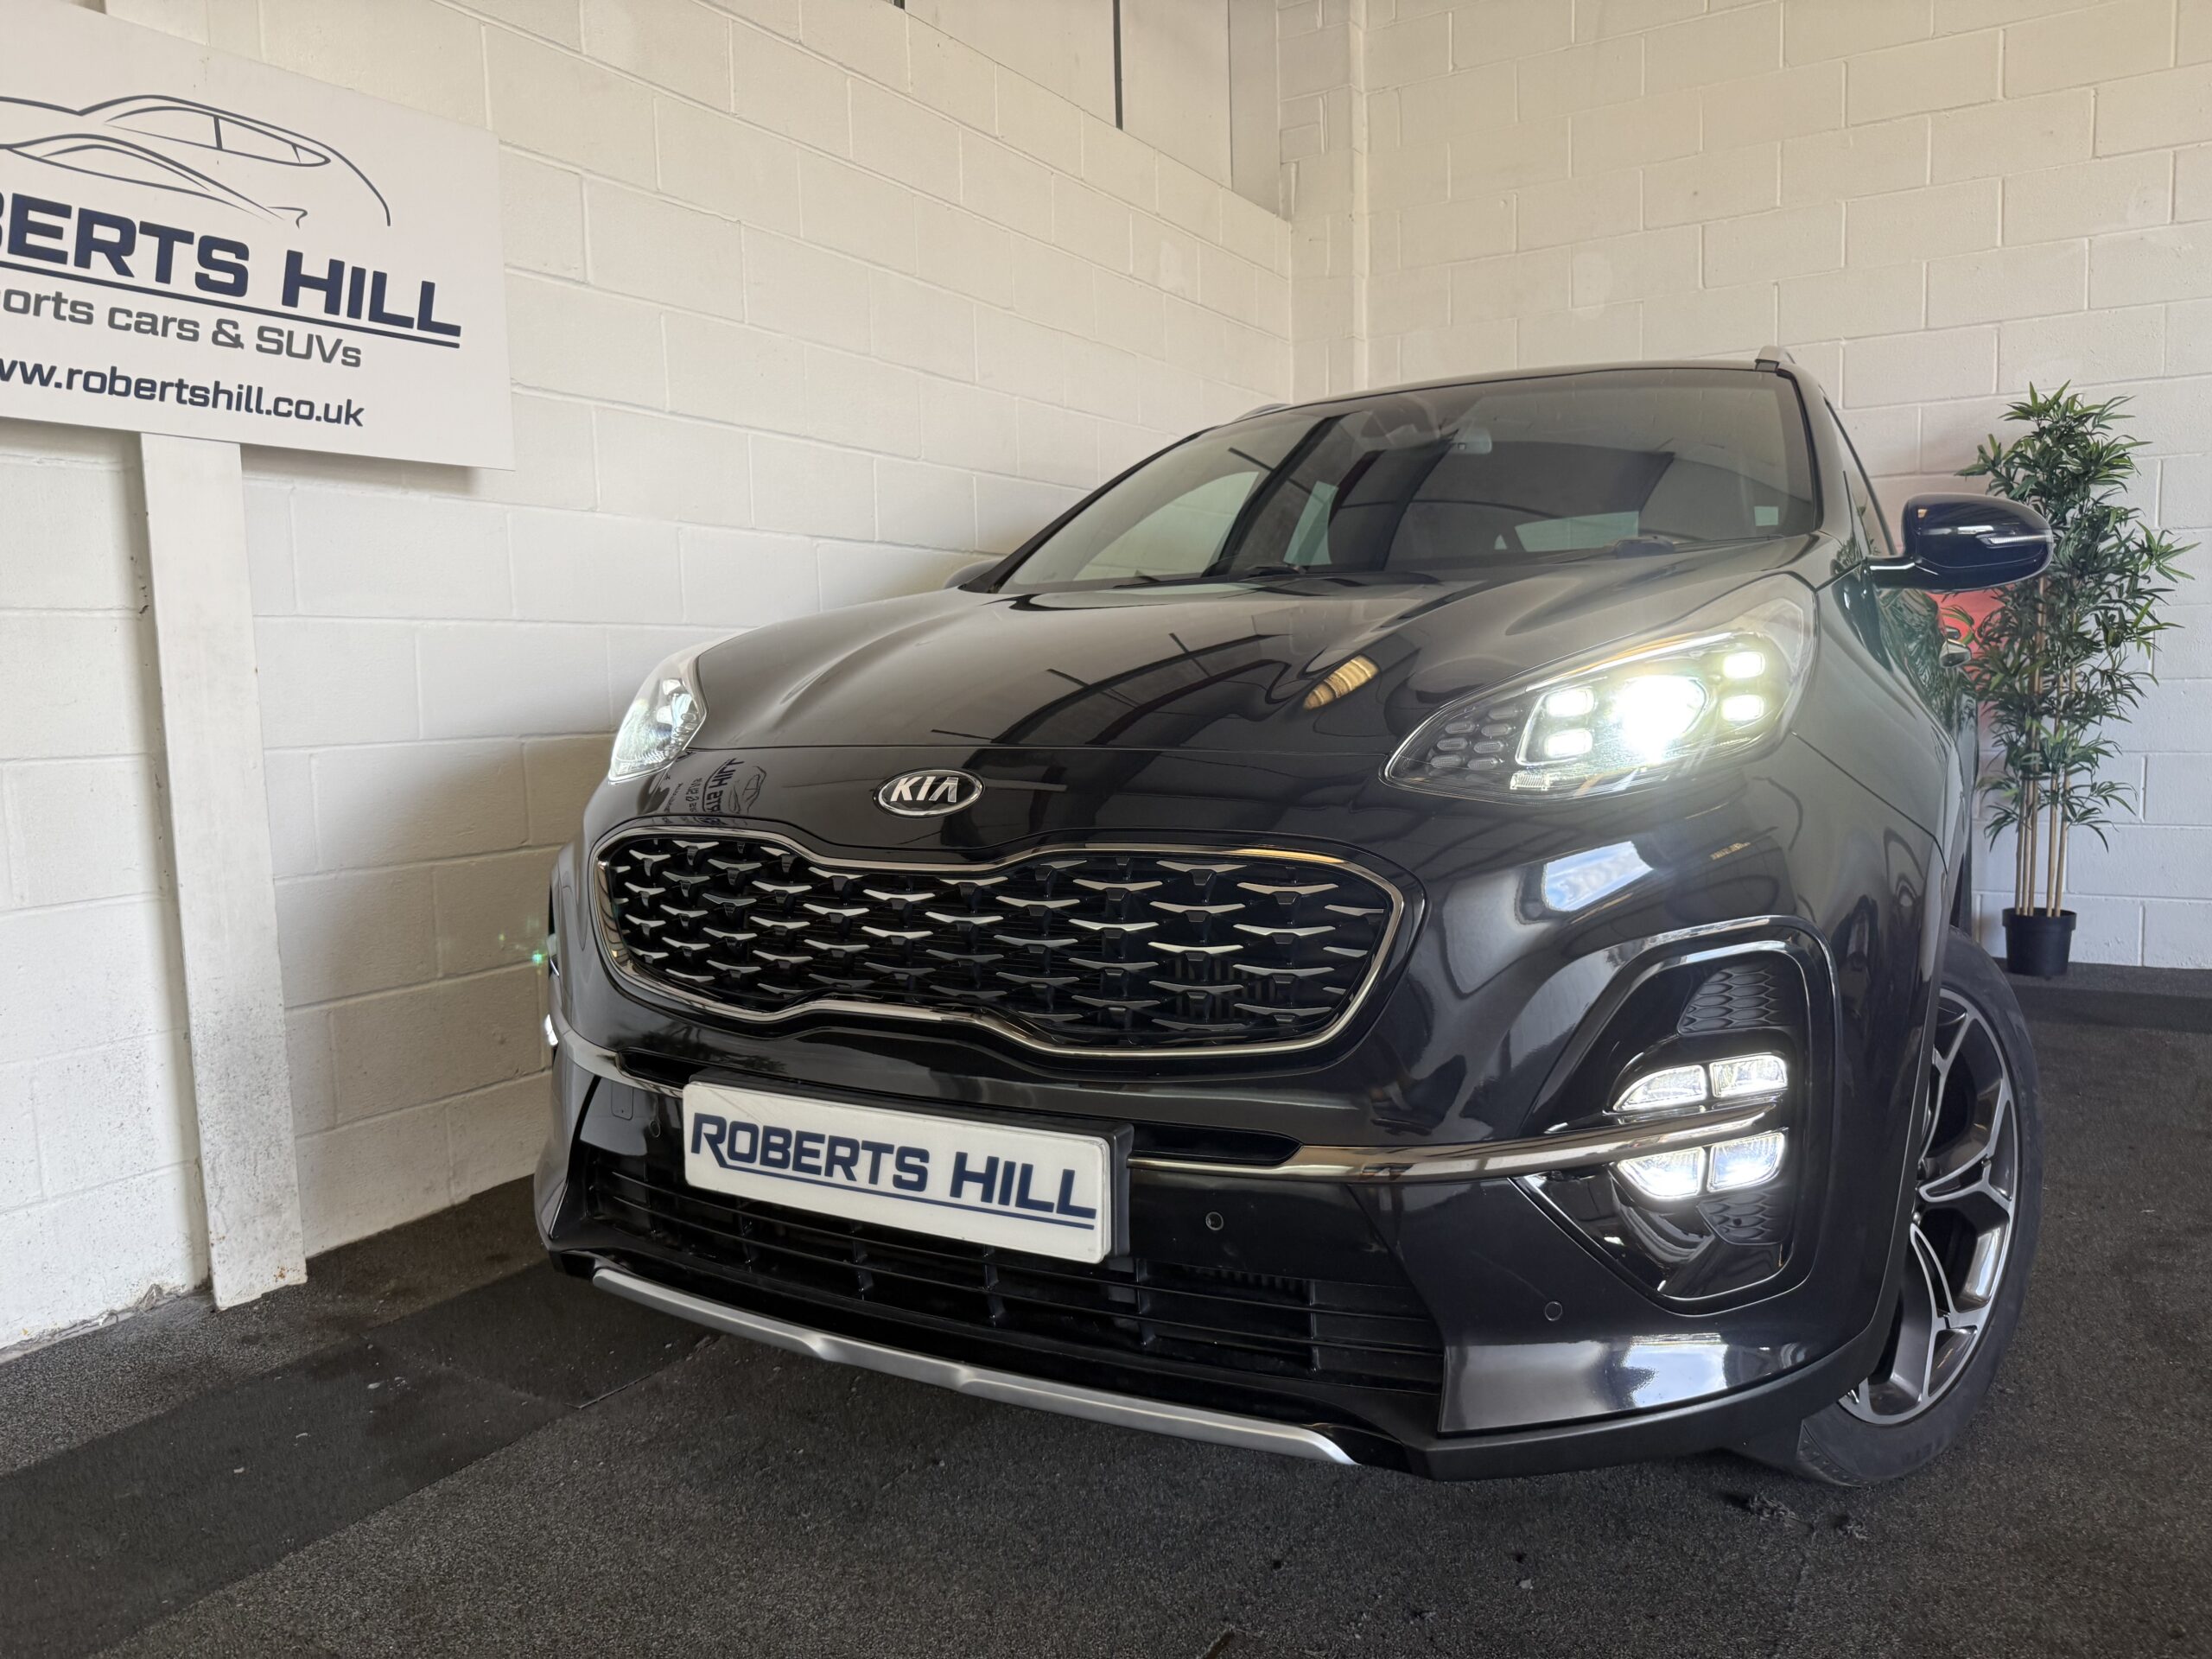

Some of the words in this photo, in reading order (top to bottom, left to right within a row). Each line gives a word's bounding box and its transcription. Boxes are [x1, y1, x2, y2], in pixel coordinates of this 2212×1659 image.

[0, 192, 249, 297] ERTS
[281, 249, 461, 338] HILL
[0, 288, 94, 325] orts
[107, 305, 200, 342] cars
[211, 317, 245, 350] &
[256, 325, 361, 368] SUVs
[890, 776, 958, 803] KIA
[691, 1112, 930, 1192] ROBERTS
[950, 1152, 1096, 1219] HILL
